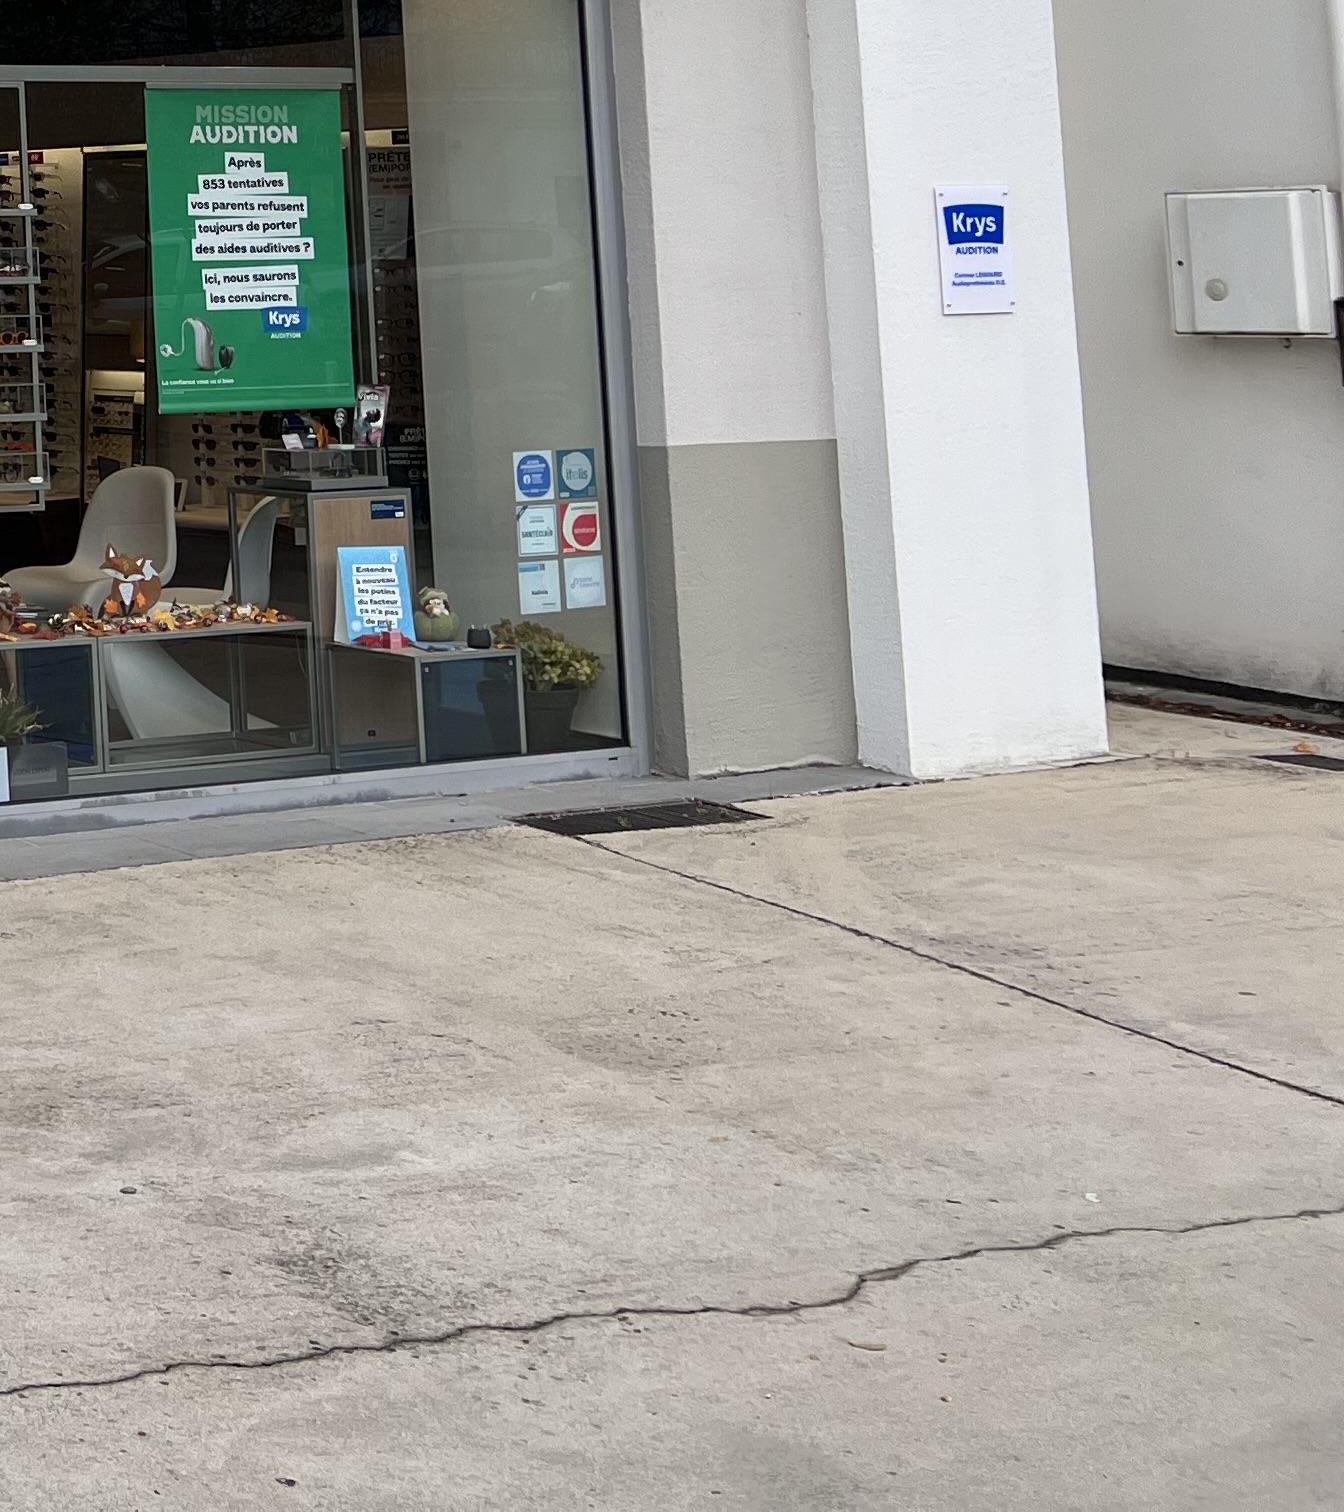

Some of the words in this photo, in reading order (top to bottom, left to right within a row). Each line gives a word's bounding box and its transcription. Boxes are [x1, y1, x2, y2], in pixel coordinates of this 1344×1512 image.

[195, 105, 288, 123] MISSION
[189, 125, 298, 144] AUDITION
[228, 157, 262, 170] Après
[202, 178, 226, 190] 853
[228, 177, 284, 189] tentatives
[191, 200, 210, 210] vos
[212, 200, 255, 213] parents
[258, 200, 305, 212] refusent
[198, 222, 244, 236] toujours
[246, 221, 260, 232] de
[262, 220, 298, 234] porter
[952, 212, 997, 237] Krys
[195, 243, 216, 255] des
[218, 242, 247, 254] aides
[250, 242, 300, 254] auditives
[956, 246, 999, 255] AUDITION
[204, 273, 220, 285] Ici,
[223, 273, 250, 284] nous
[252, 272, 296, 282] saurons
[210, 292, 226, 304] les
[228, 292, 293, 302] convaincre.
[269, 311, 300, 328] Krys
